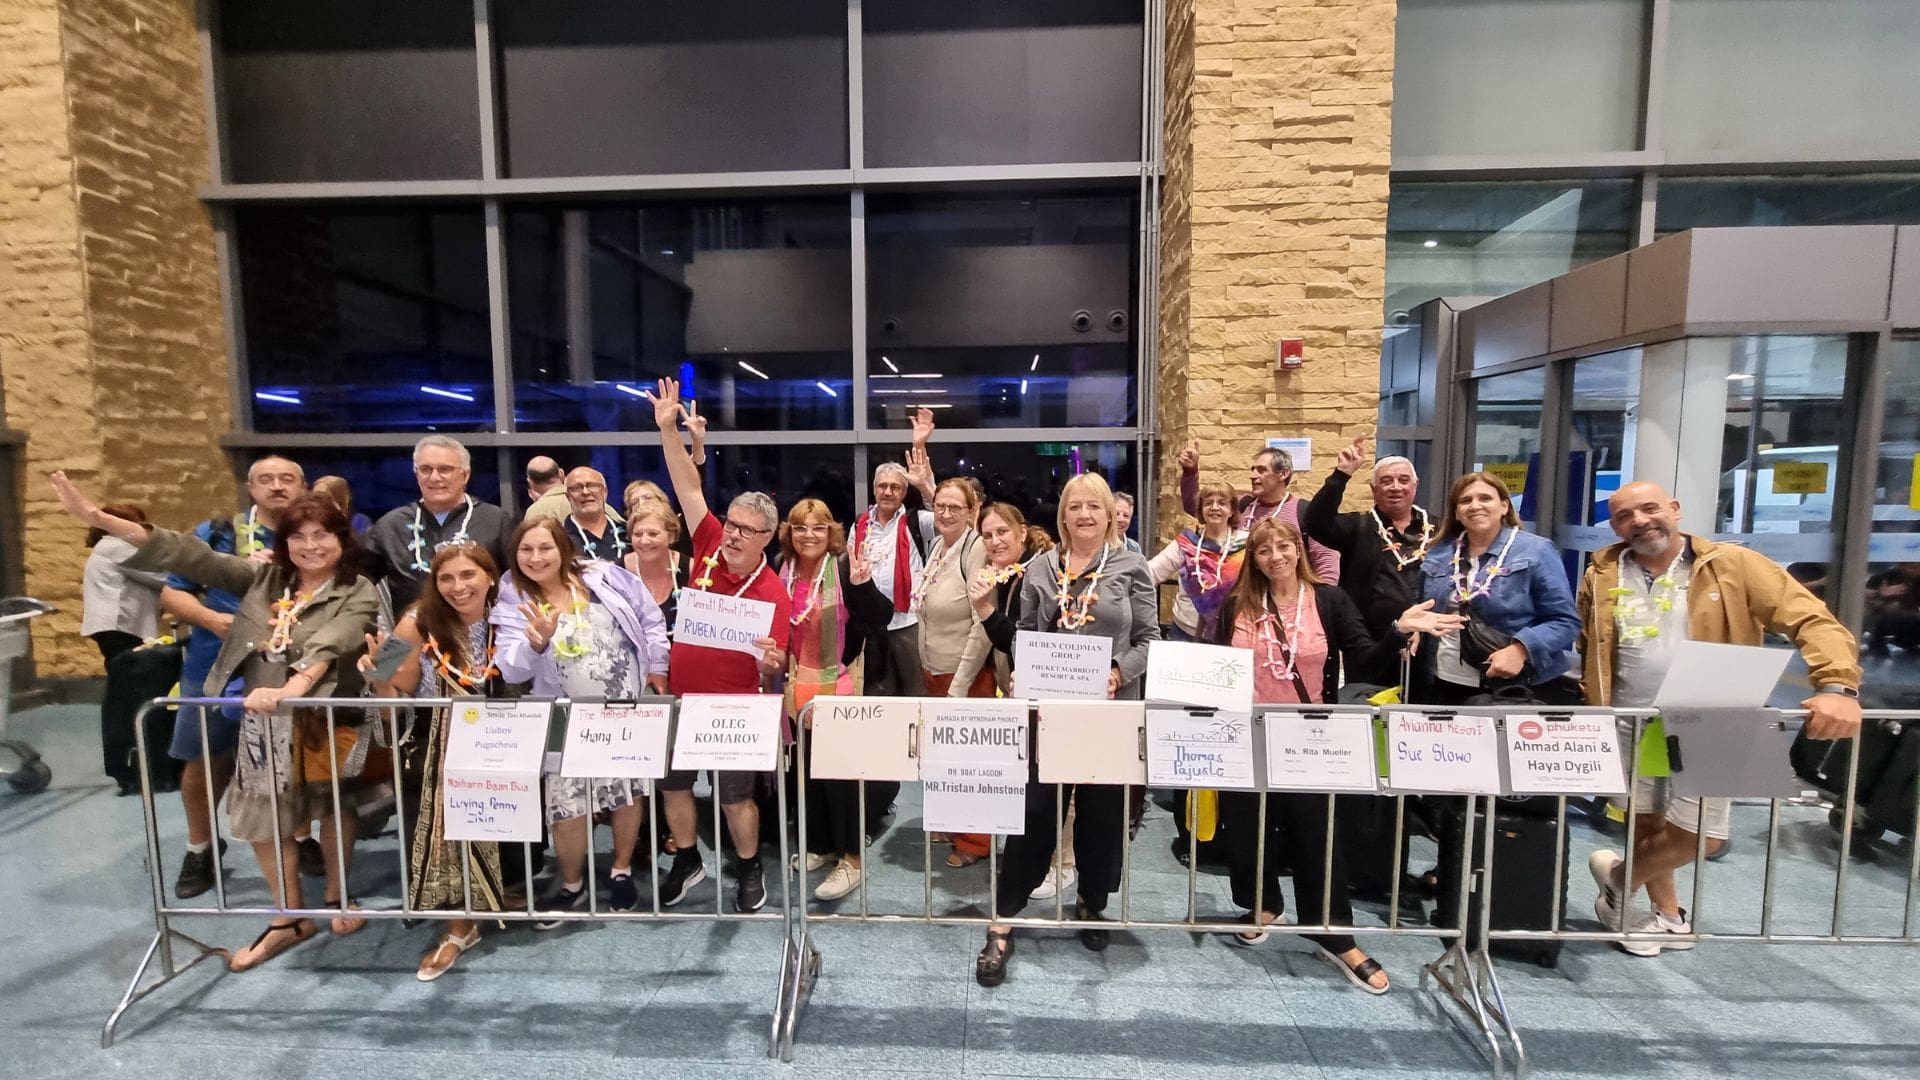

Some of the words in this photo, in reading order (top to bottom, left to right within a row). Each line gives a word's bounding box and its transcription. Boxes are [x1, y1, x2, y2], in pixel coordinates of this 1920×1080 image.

[684, 618, 717, 639] RUBEN
[1028, 640, 1057, 649] RUBEN
[1059, 642, 1103, 652] COLDMAN
[1051, 651, 1081, 660] GROUP
[1031, 664, 1060, 672] PHUKET
[1061, 666, 1100, 675] MARRIOTT
[1040, 673, 1068, 681] RESORT
[578, 708, 595, 721] The
[833, 705, 885, 721] NONG
[936, 714, 960, 722] RAMADA
[711, 718, 746, 729] OLEG
[1447, 719, 1483, 736] Resort
[622, 727, 632, 741] Li
[694, 732, 760, 744] KOMAROV
[932, 726, 1019, 746] MR.SAMUEL
[475, 740, 518, 750] Pugacheva
[1397, 741, 1422, 762] Sue
[1513, 741, 1559, 752] Ahmad
[1564, 741, 1597, 753] Alani
[1601, 741, 1612, 753] &
[1175, 745, 1224, 763] Thomas
[1302, 748, 1319, 756] Rita
[1322, 748, 1352, 757] Mueller
[978, 769, 1003, 777] LAGOON
[1527, 759, 1560, 774] Haya
[1564, 760, 1602, 775] Dygili
[486, 780, 508, 792] Baan
[510, 781, 529, 793] Bua
[925, 781, 974, 794] MR.Tristan
[977, 783, 1025, 796] Johnstone
[489, 796, 518, 815] Penny
